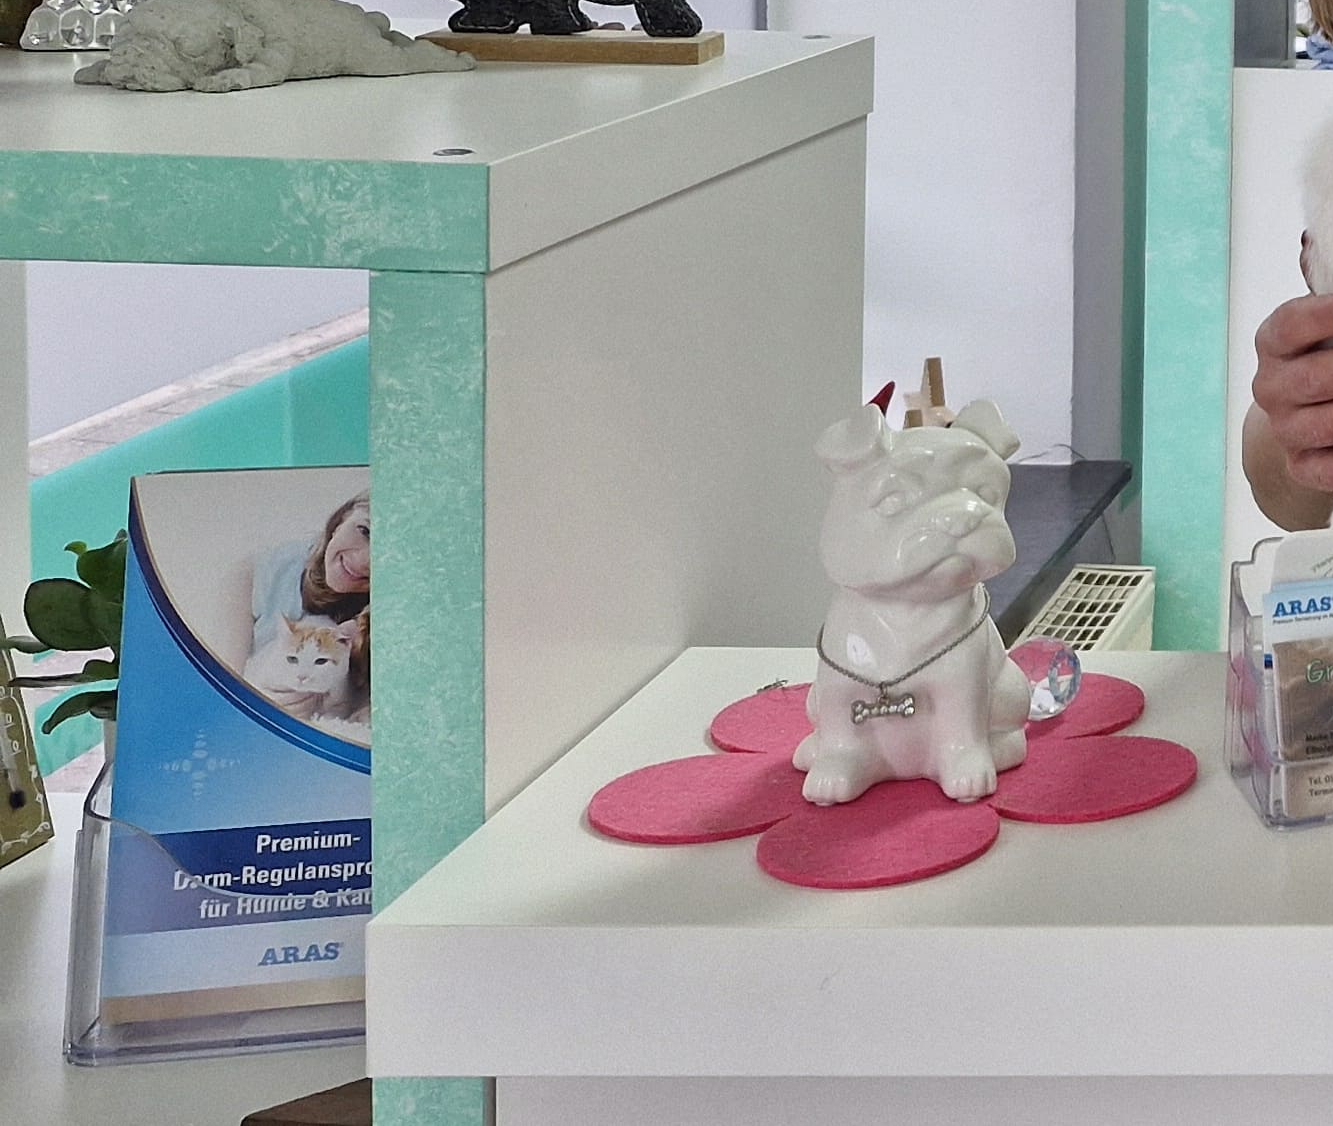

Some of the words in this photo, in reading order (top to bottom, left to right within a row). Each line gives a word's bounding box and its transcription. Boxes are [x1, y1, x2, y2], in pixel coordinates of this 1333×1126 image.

[1272, 596, 1333, 618] ARAS
[256, 831, 361, 853] Premium-
[200, 898, 231, 919] für
[237, 892, 306, 916] Hunde
[312, 890, 330, 908] &
[258, 942, 341, 967] ARAS
